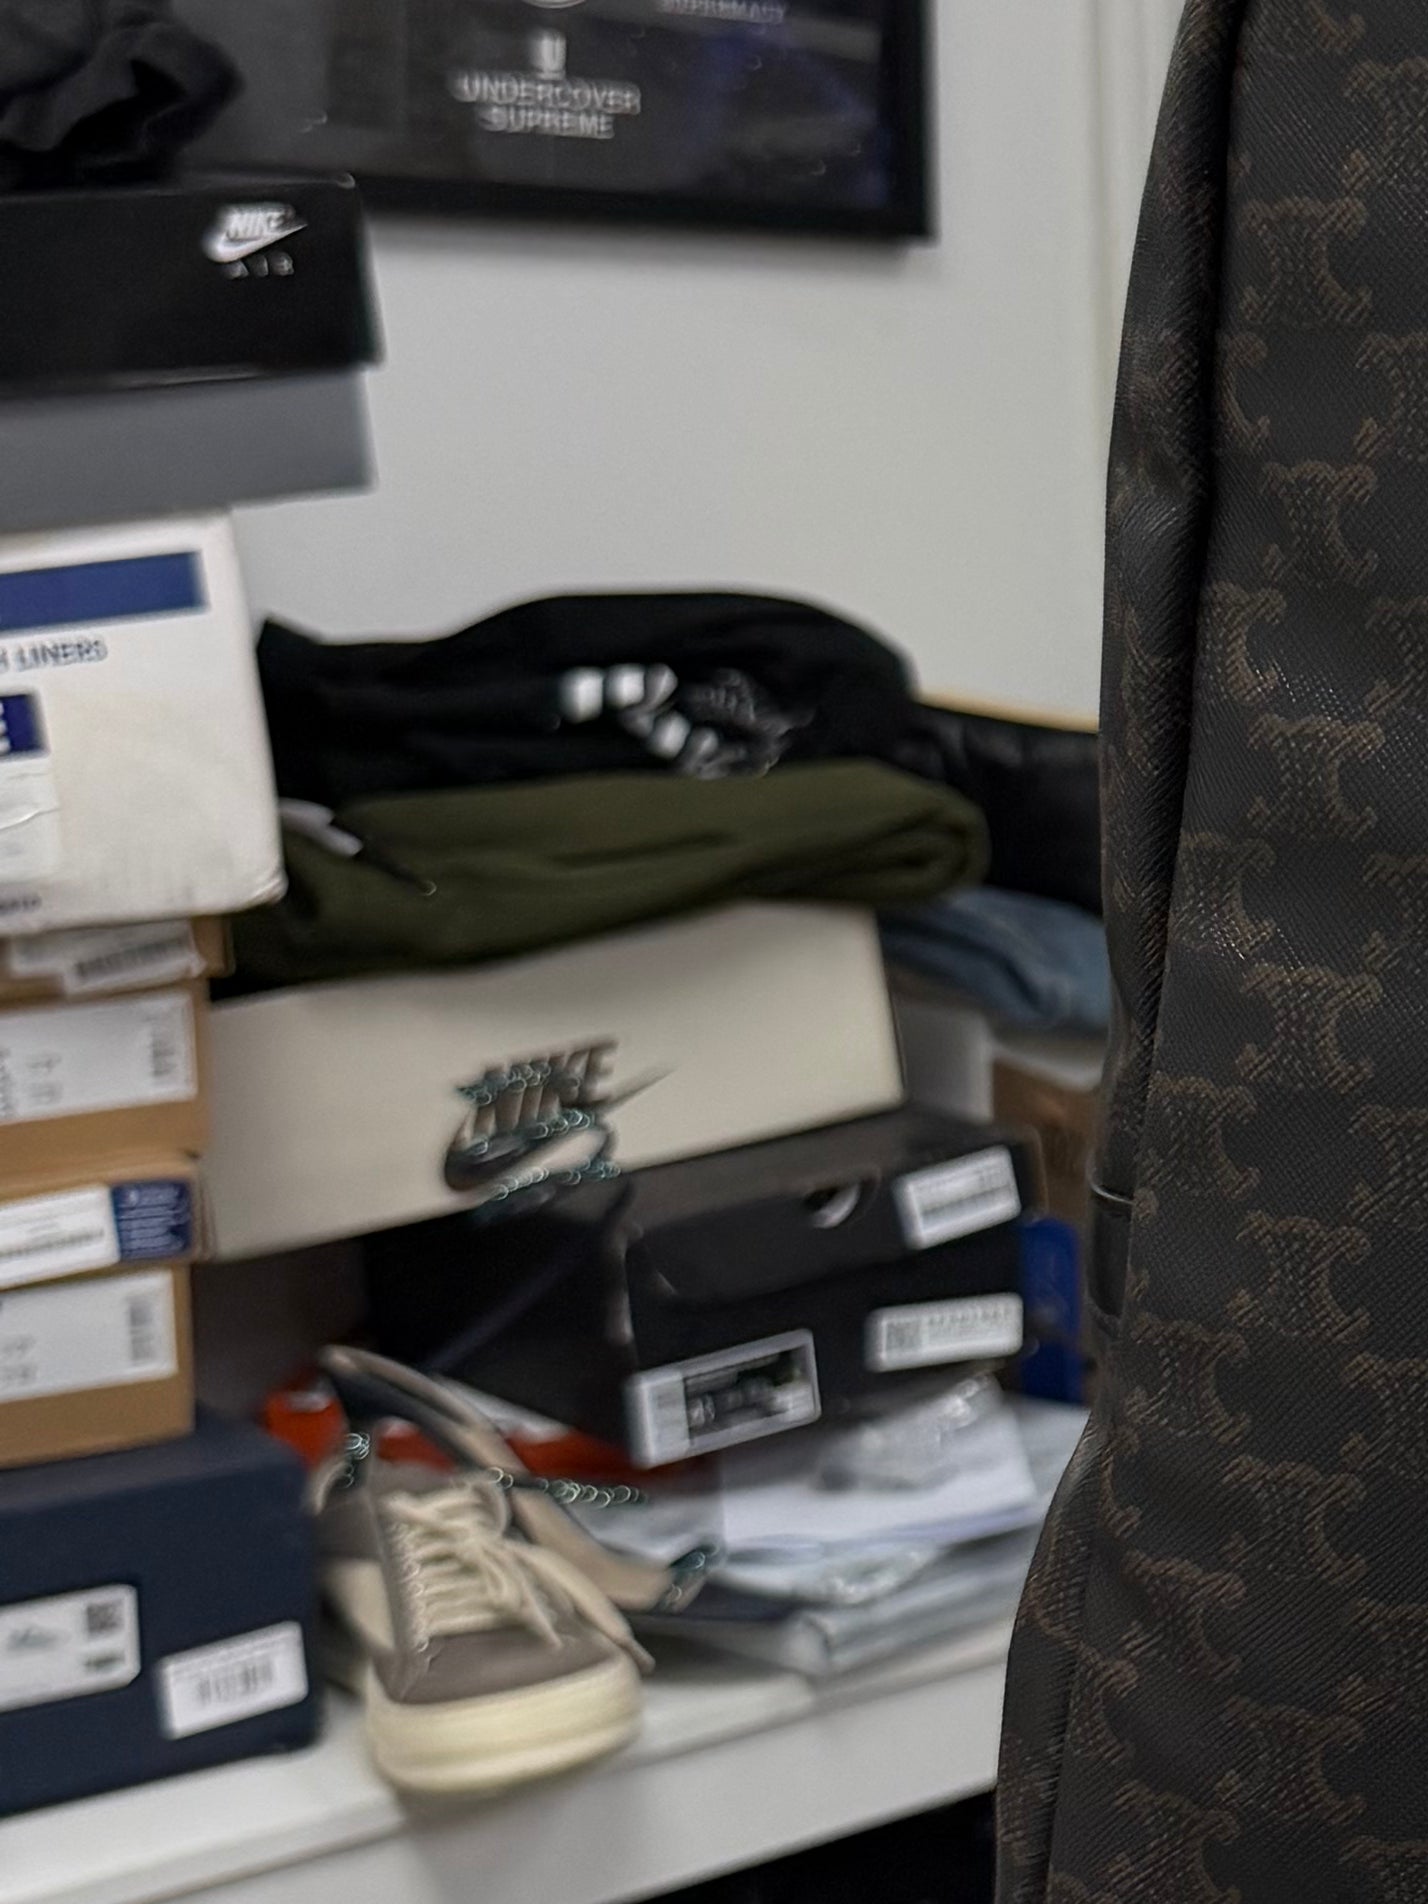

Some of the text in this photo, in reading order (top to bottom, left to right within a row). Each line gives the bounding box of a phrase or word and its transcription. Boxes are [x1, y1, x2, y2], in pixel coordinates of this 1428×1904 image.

[450, 70, 641, 115] UNDERCOVER
[477, 104, 615, 139] SUPREME
[15, 639, 108, 672] LINERS
